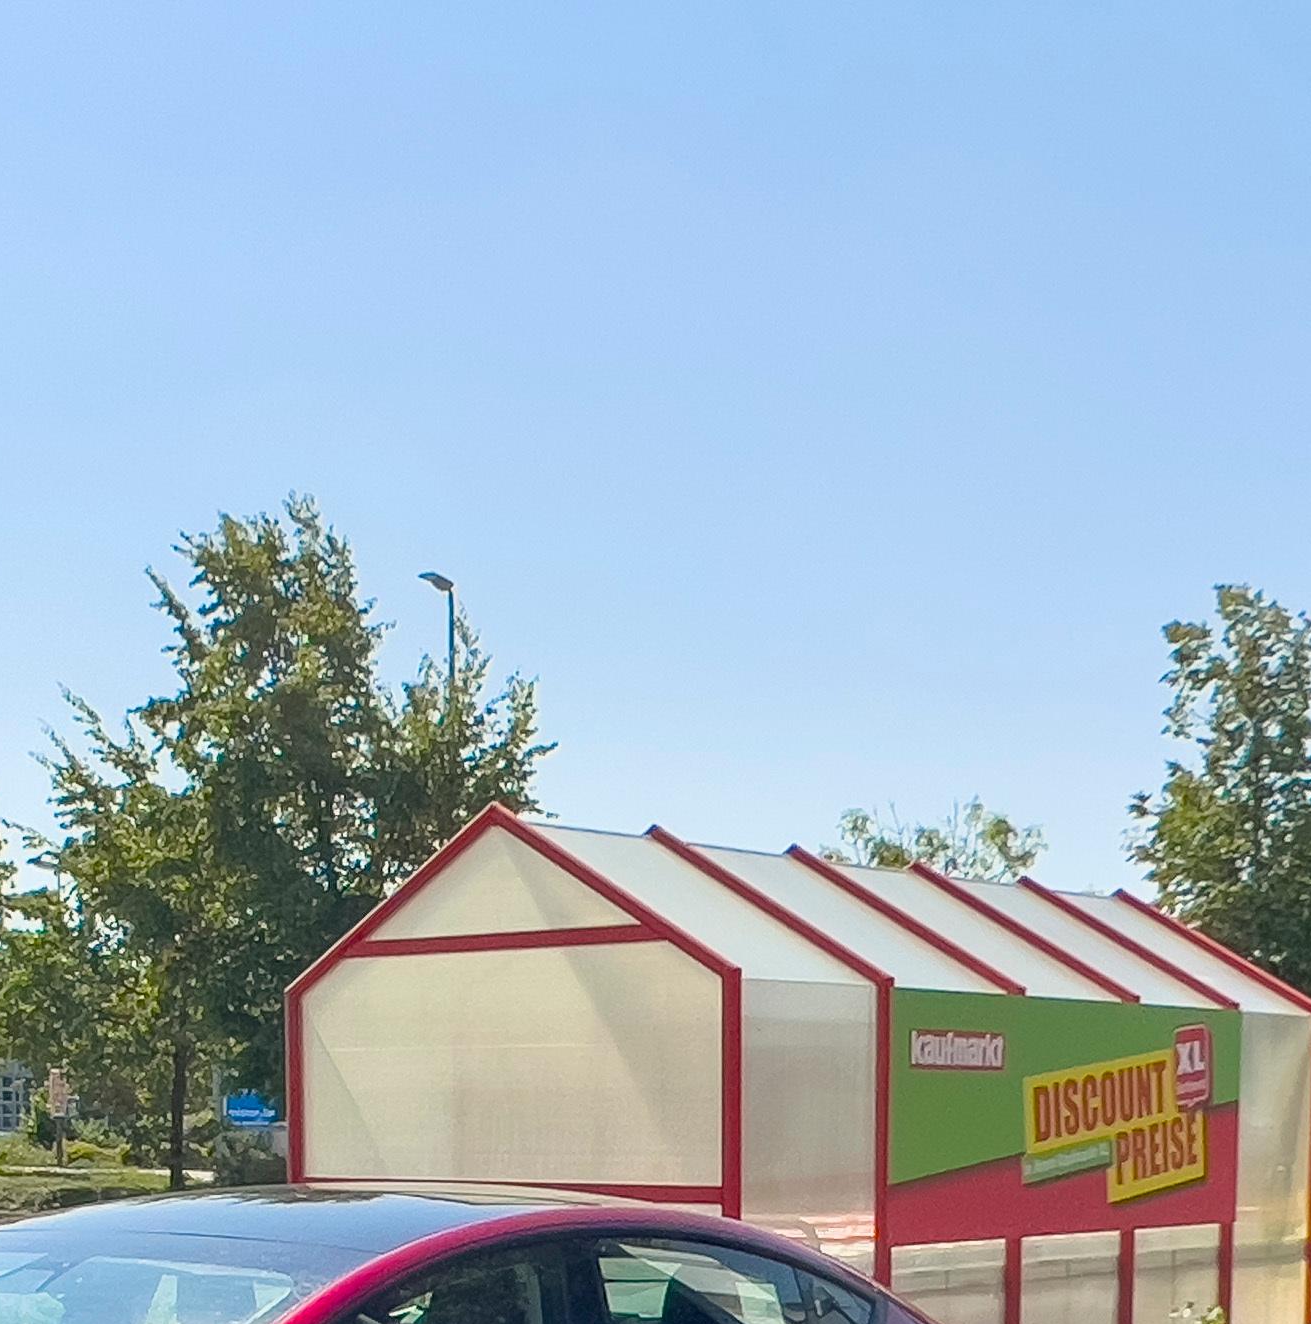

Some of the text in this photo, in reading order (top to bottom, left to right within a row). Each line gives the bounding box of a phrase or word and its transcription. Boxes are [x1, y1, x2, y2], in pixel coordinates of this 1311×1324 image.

[1176, 1040, 1206, 1075] XL
[1033, 1060, 1168, 1144] DISCOUNT
[1116, 1111, 1198, 1186] PREISE
